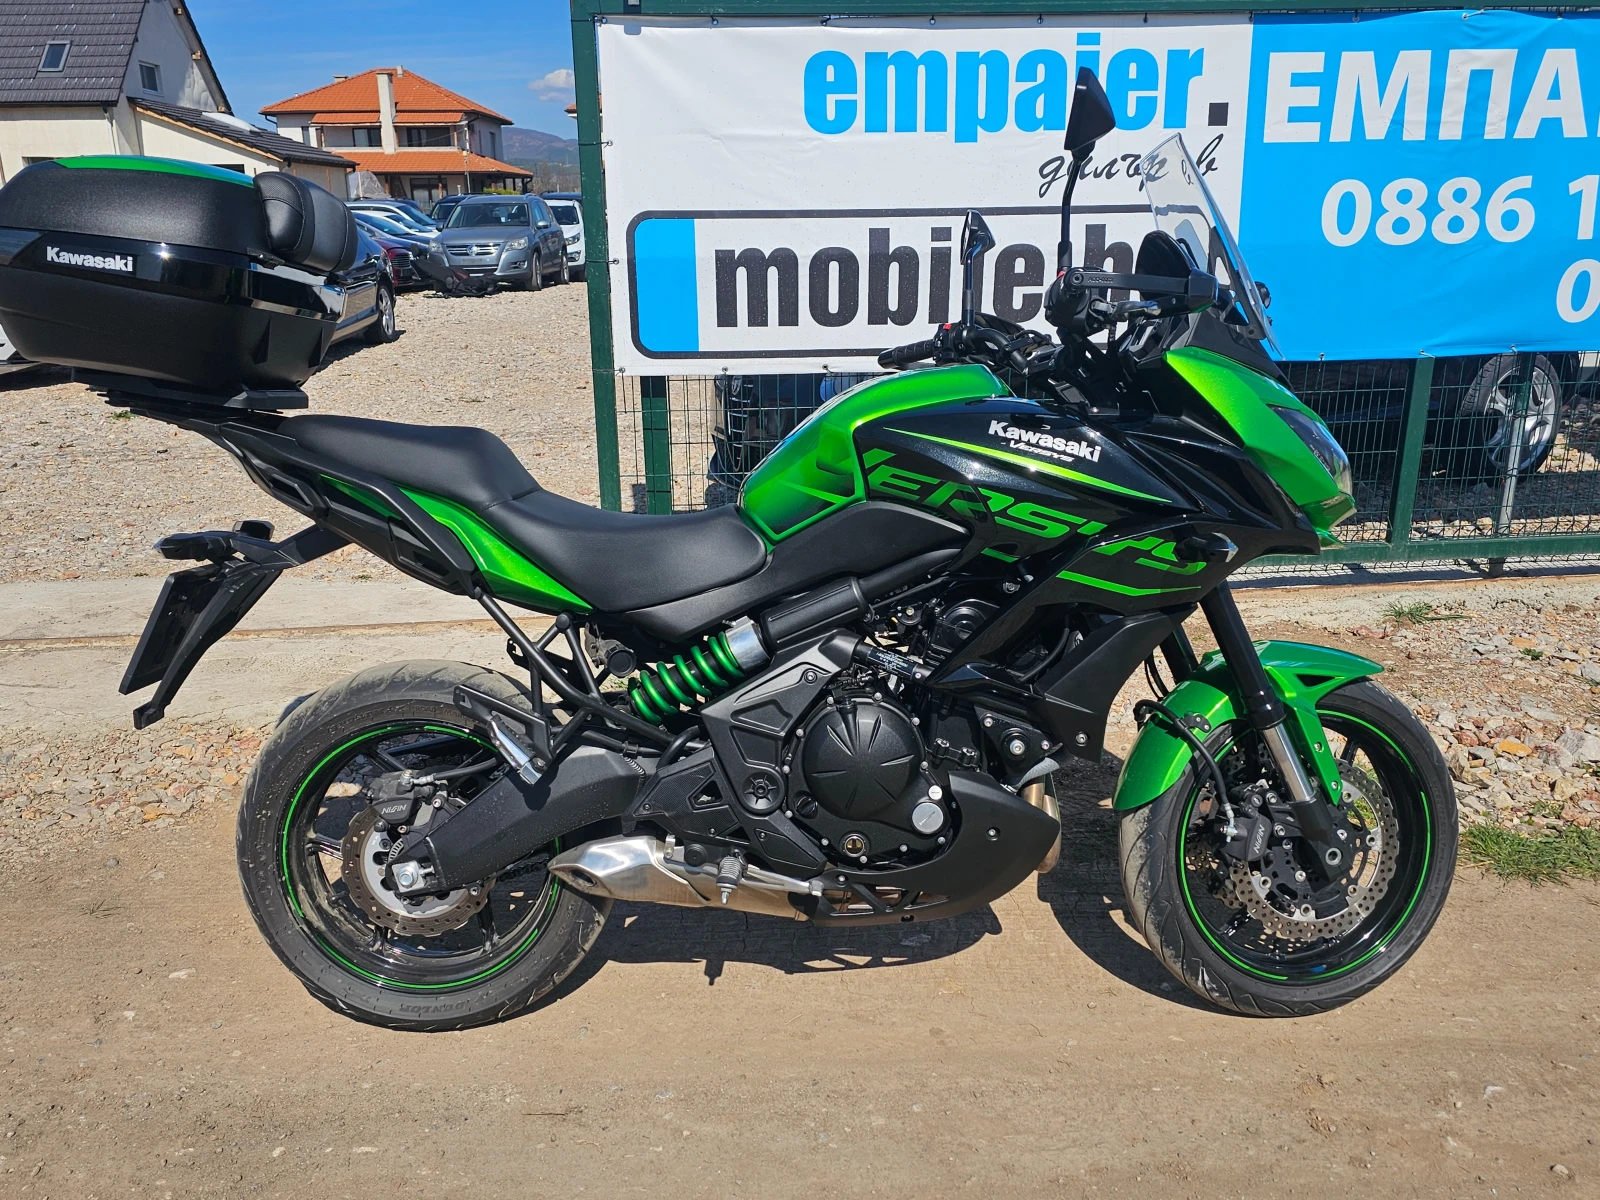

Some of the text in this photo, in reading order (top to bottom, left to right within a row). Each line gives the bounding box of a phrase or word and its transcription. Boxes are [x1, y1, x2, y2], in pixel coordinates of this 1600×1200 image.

[1263, 48, 1600, 144] ЕМПА
[1321, 175, 1536, 247] 0886
[46, 246, 133, 272] Kawasaki
[1556, 258, 1600, 323] 0
[988, 419, 1102, 463] Kawasaki
